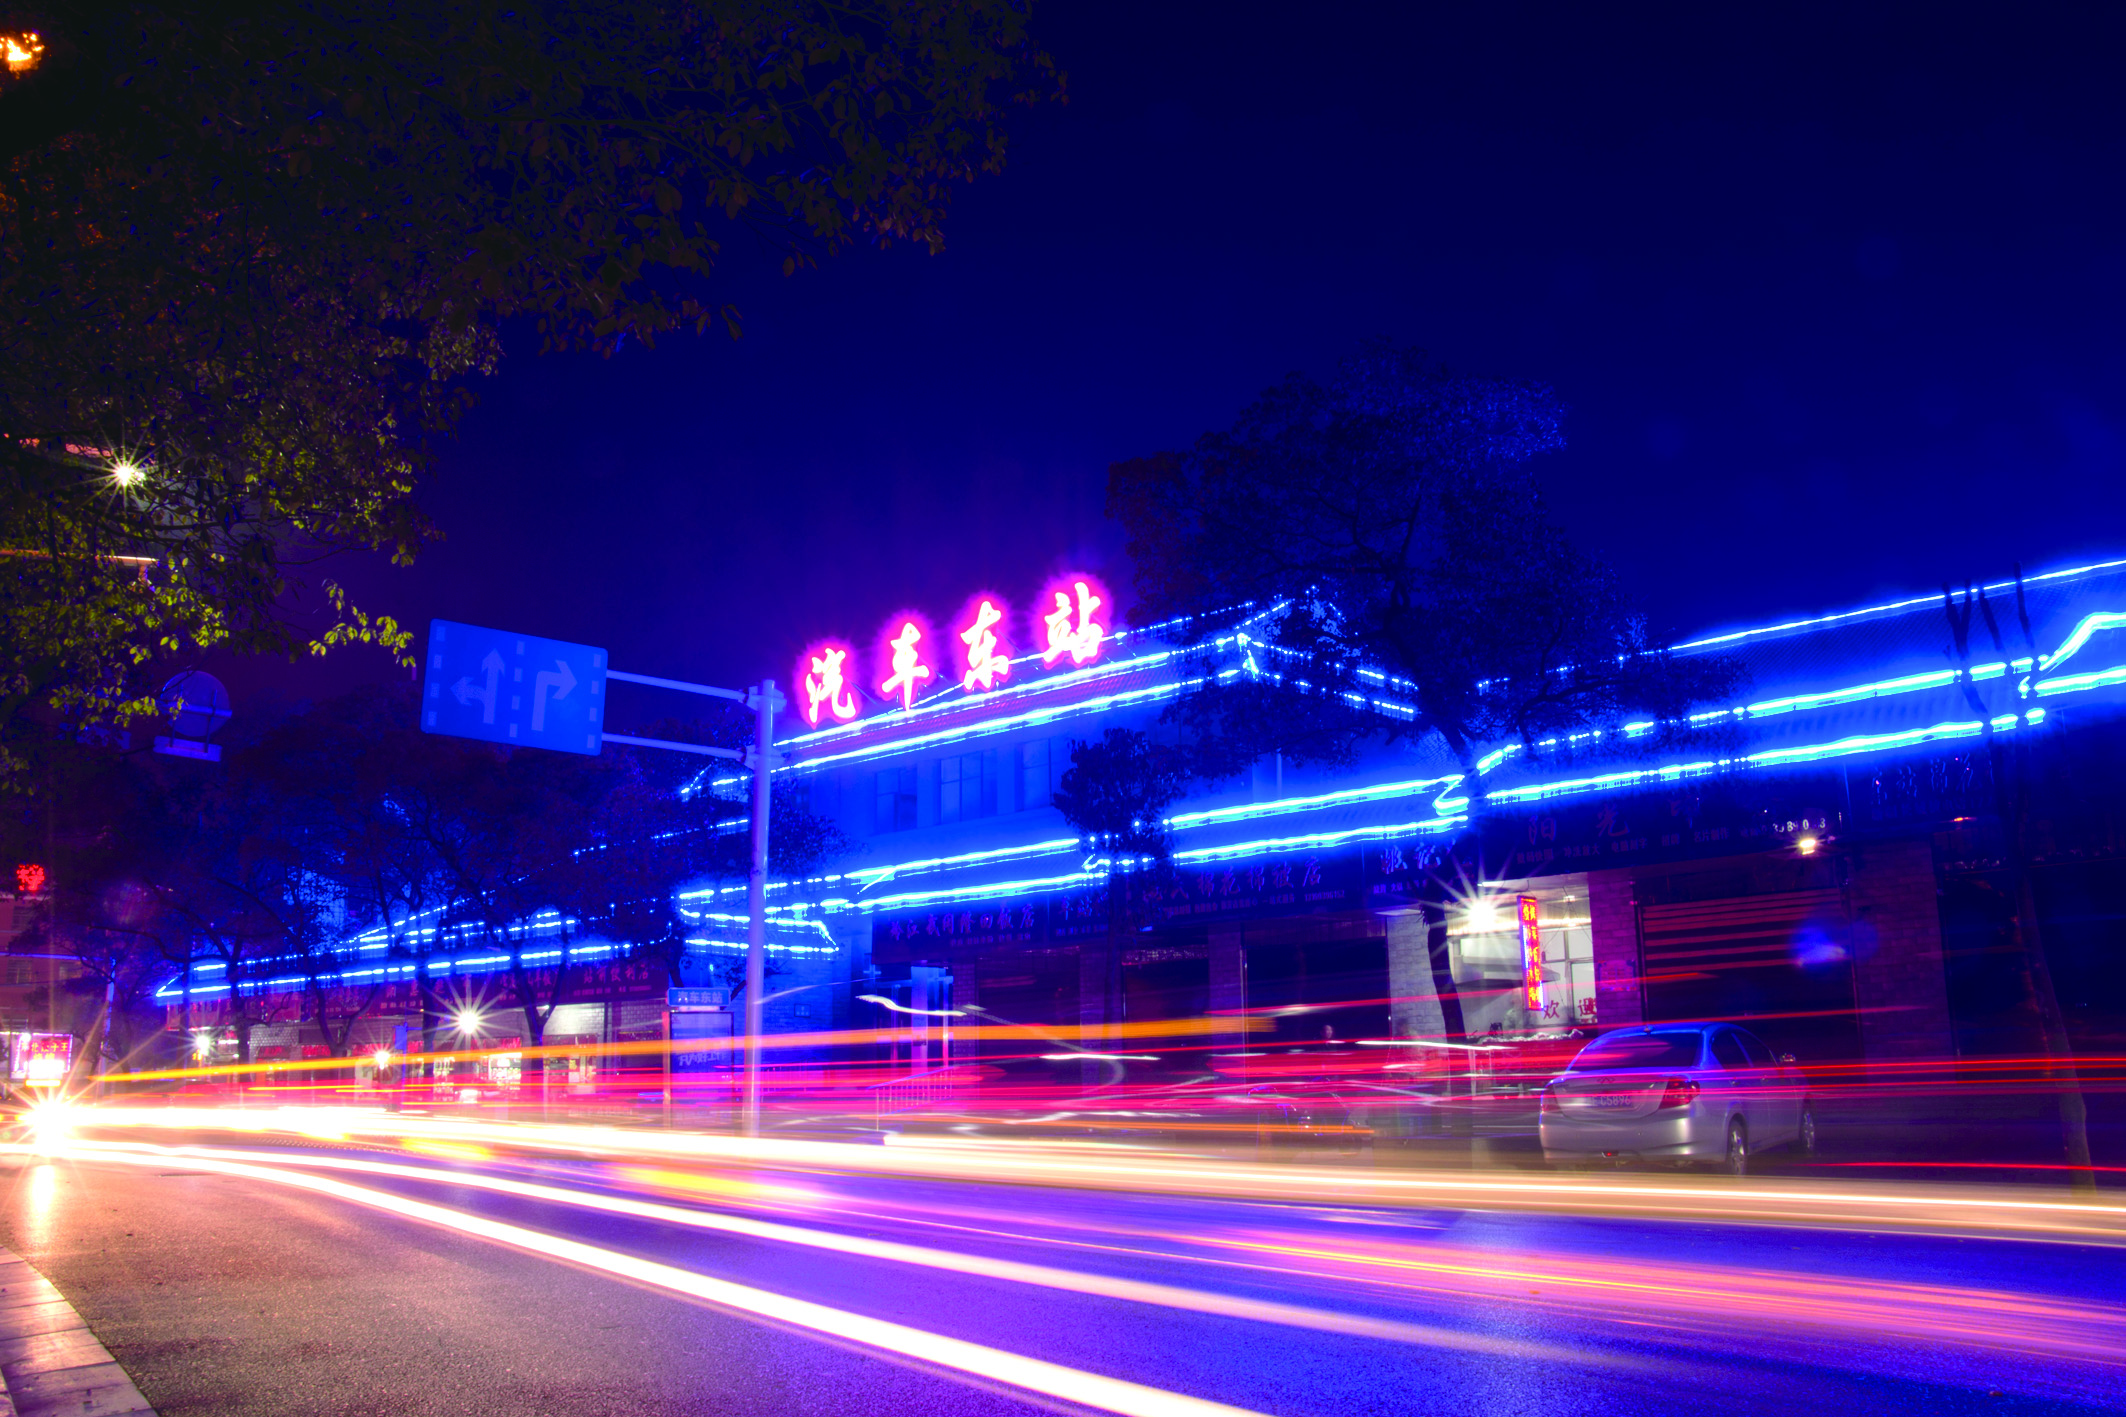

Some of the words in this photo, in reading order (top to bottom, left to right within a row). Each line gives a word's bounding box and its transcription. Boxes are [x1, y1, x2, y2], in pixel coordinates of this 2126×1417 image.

[805, 581, 1106, 725] 汽车东站
[677, 990, 724, 1005] 汽车东站
